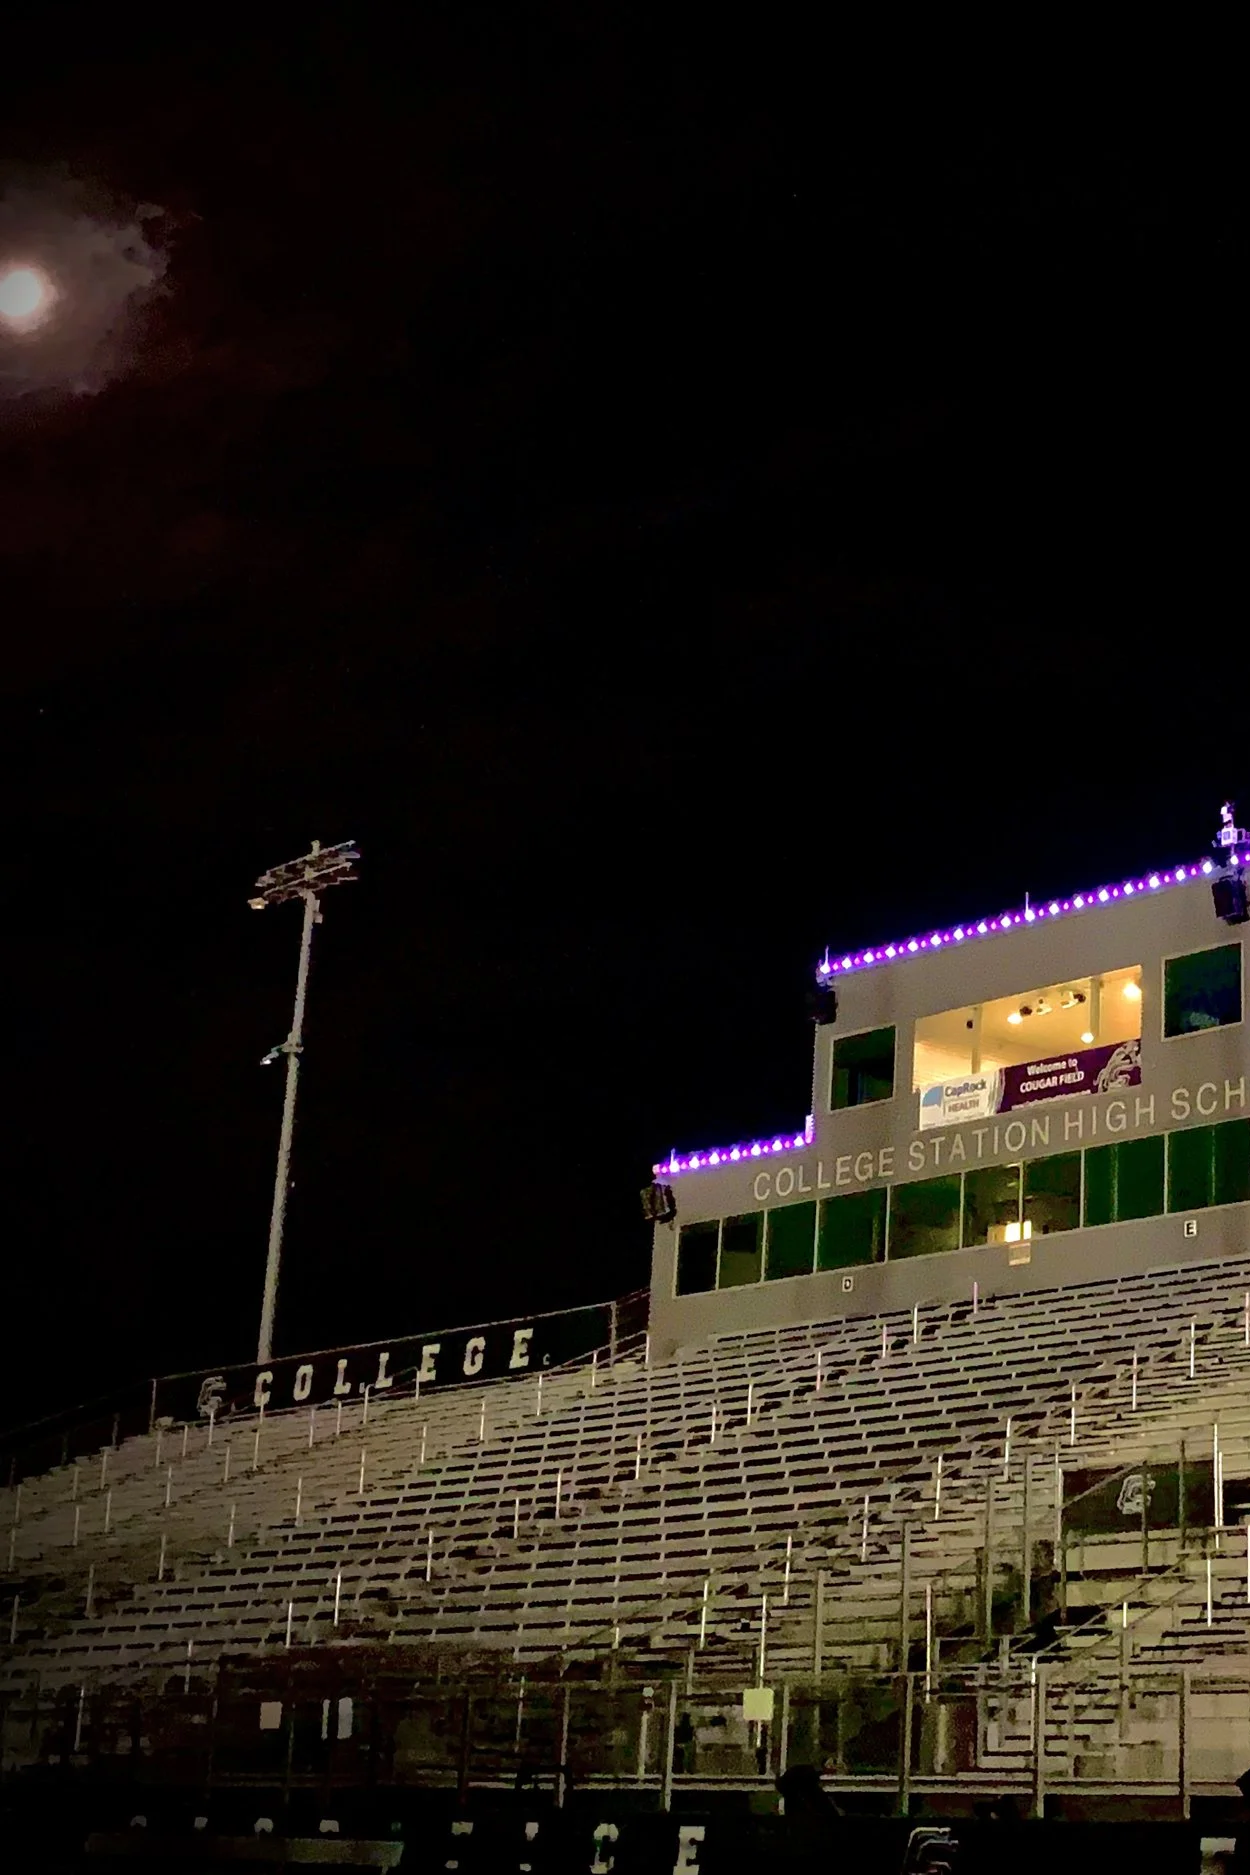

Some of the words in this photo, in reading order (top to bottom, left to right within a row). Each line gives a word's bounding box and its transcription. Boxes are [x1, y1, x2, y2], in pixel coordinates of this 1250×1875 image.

[1027, 1061, 1067, 1076] Welcome
[1068, 1058, 1078, 1069] to
[945, 1079, 986, 1097] CapRock
[1020, 1075, 1058, 1094] COUGAR
[1059, 1070, 1085, 1086] FIELD
[948, 1099, 980, 1112] HEALTH
[754, 1146, 895, 1201] COLLEGE
[908, 1115, 1050, 1172] STATION
[1064, 1094, 1155, 1141] HIGH
[1185, 1222, 1195, 1236] E
[253, 1328, 534, 1406] COLLEGE
